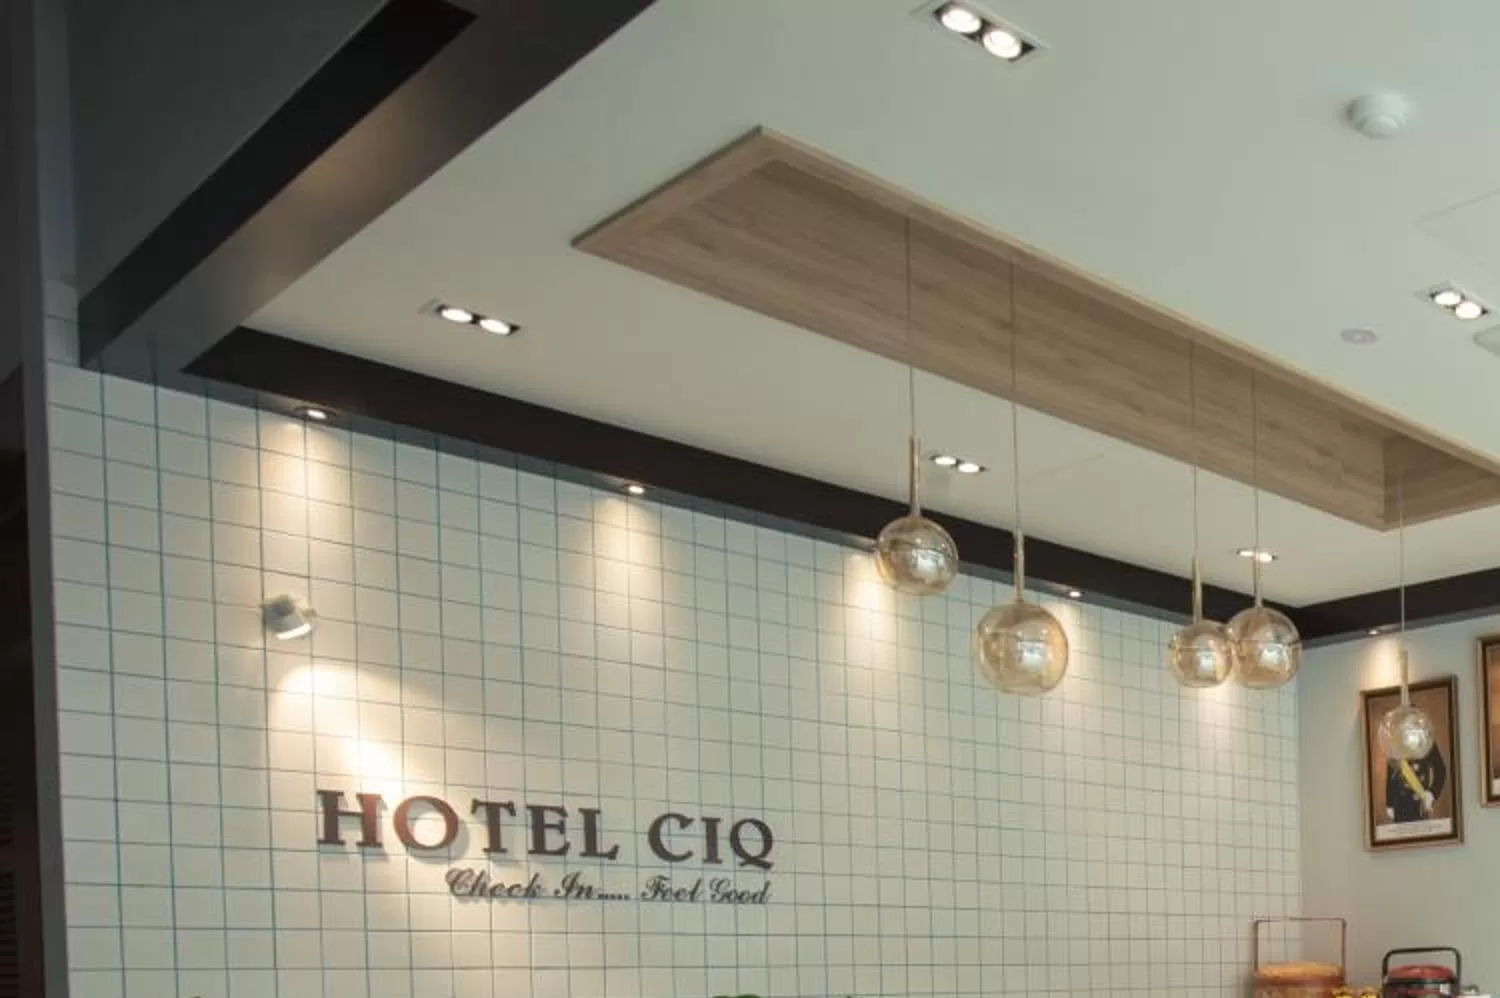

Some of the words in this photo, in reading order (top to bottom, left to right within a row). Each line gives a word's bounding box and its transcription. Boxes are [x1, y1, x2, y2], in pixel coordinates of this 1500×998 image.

[316, 789, 620, 860] HOTEL
[648, 812, 774, 870] CIQ
[445, 867, 541, 898] Check
[640, 875, 704, 902] Feel
[708, 876, 771, 904] Good
